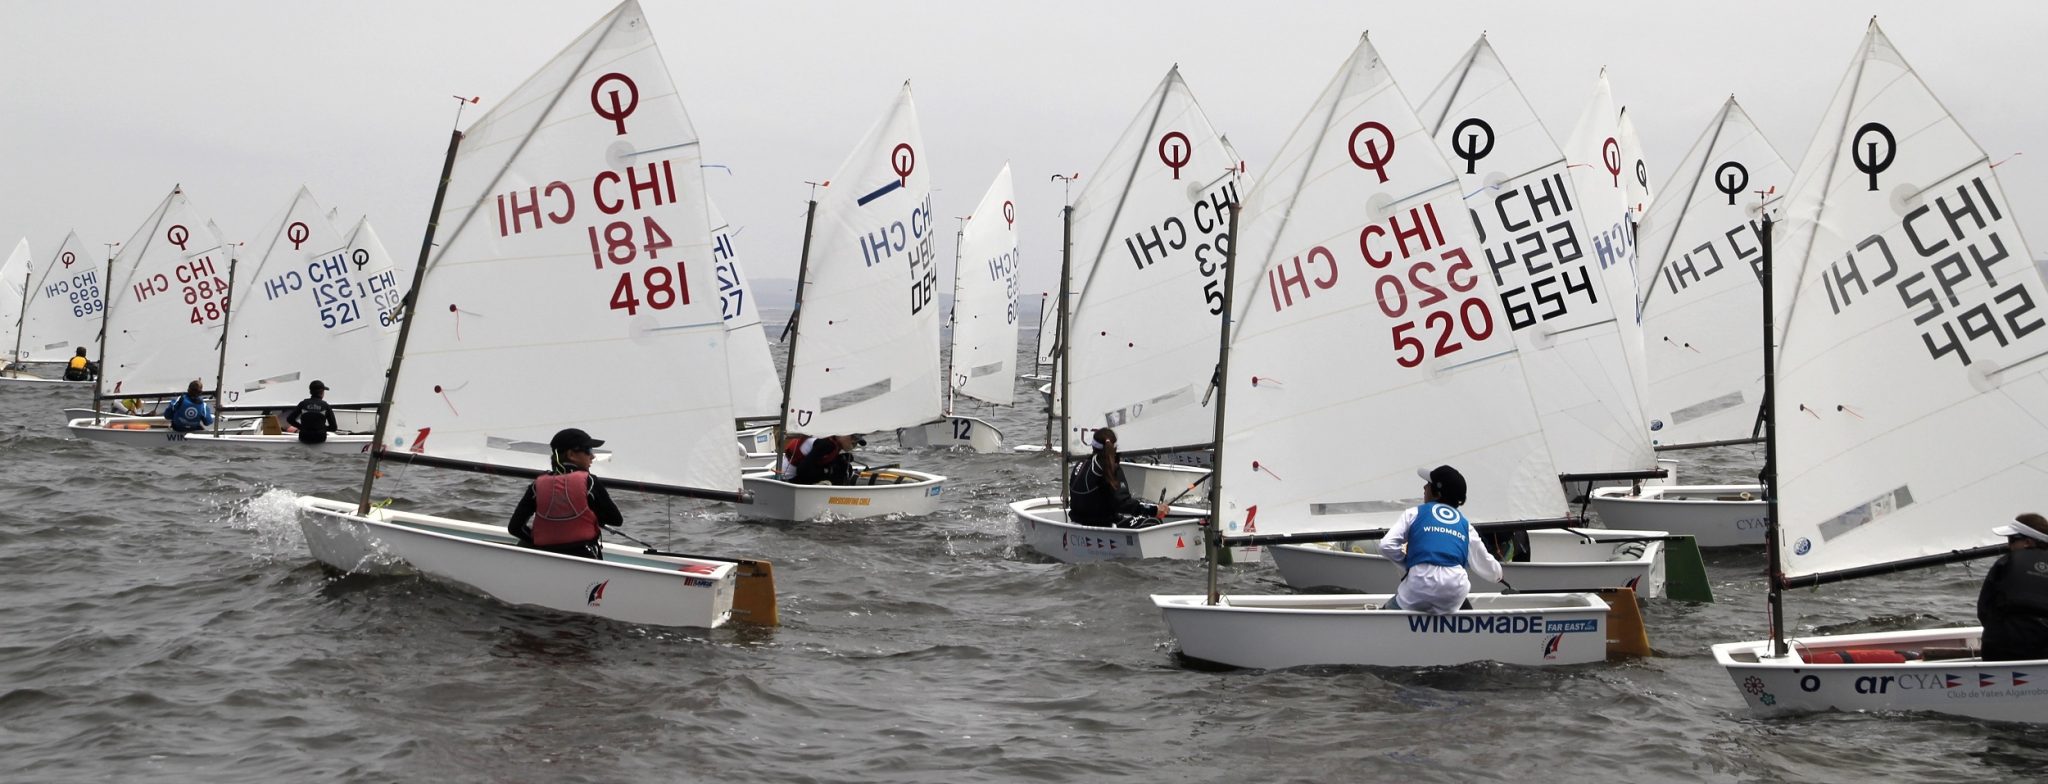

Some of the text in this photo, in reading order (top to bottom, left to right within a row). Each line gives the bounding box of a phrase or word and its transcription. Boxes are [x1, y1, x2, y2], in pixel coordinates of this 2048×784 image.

[593, 160, 676, 214] CHI
[912, 192, 932, 239] CHI
[1194, 181, 1240, 234] CHI
[1495, 174, 1573, 232] CHI
[1902, 177, 2002, 257] CHI
[1360, 202, 1446, 268] CHI
[72, 271, 97, 288] CHI
[176, 256, 215, 284] CHI
[308, 254, 348, 283] CHI
[368, 270, 396, 294] CHI
[610, 262, 690, 316] 481
[1500, 266, 1598, 332] 654
[74, 300, 103, 318] 699
[320, 300, 360, 328] 521
[720, 289, 742, 320] 27
[1392, 298, 1494, 368] 520
[1922, 283, 2046, 366] 492
[952, 418, 971, 440] 12
[1548, 624, 1562, 632] FAR
[1564, 622, 1585, 631] EAST
[1855, 674, 1894, 694] ar
[1898, 674, 1946, 690] CYA
[1946, 690, 1966, 698] Club
[1968, 690, 1979, 698] de
[1980, 689, 2004, 698] Yates
